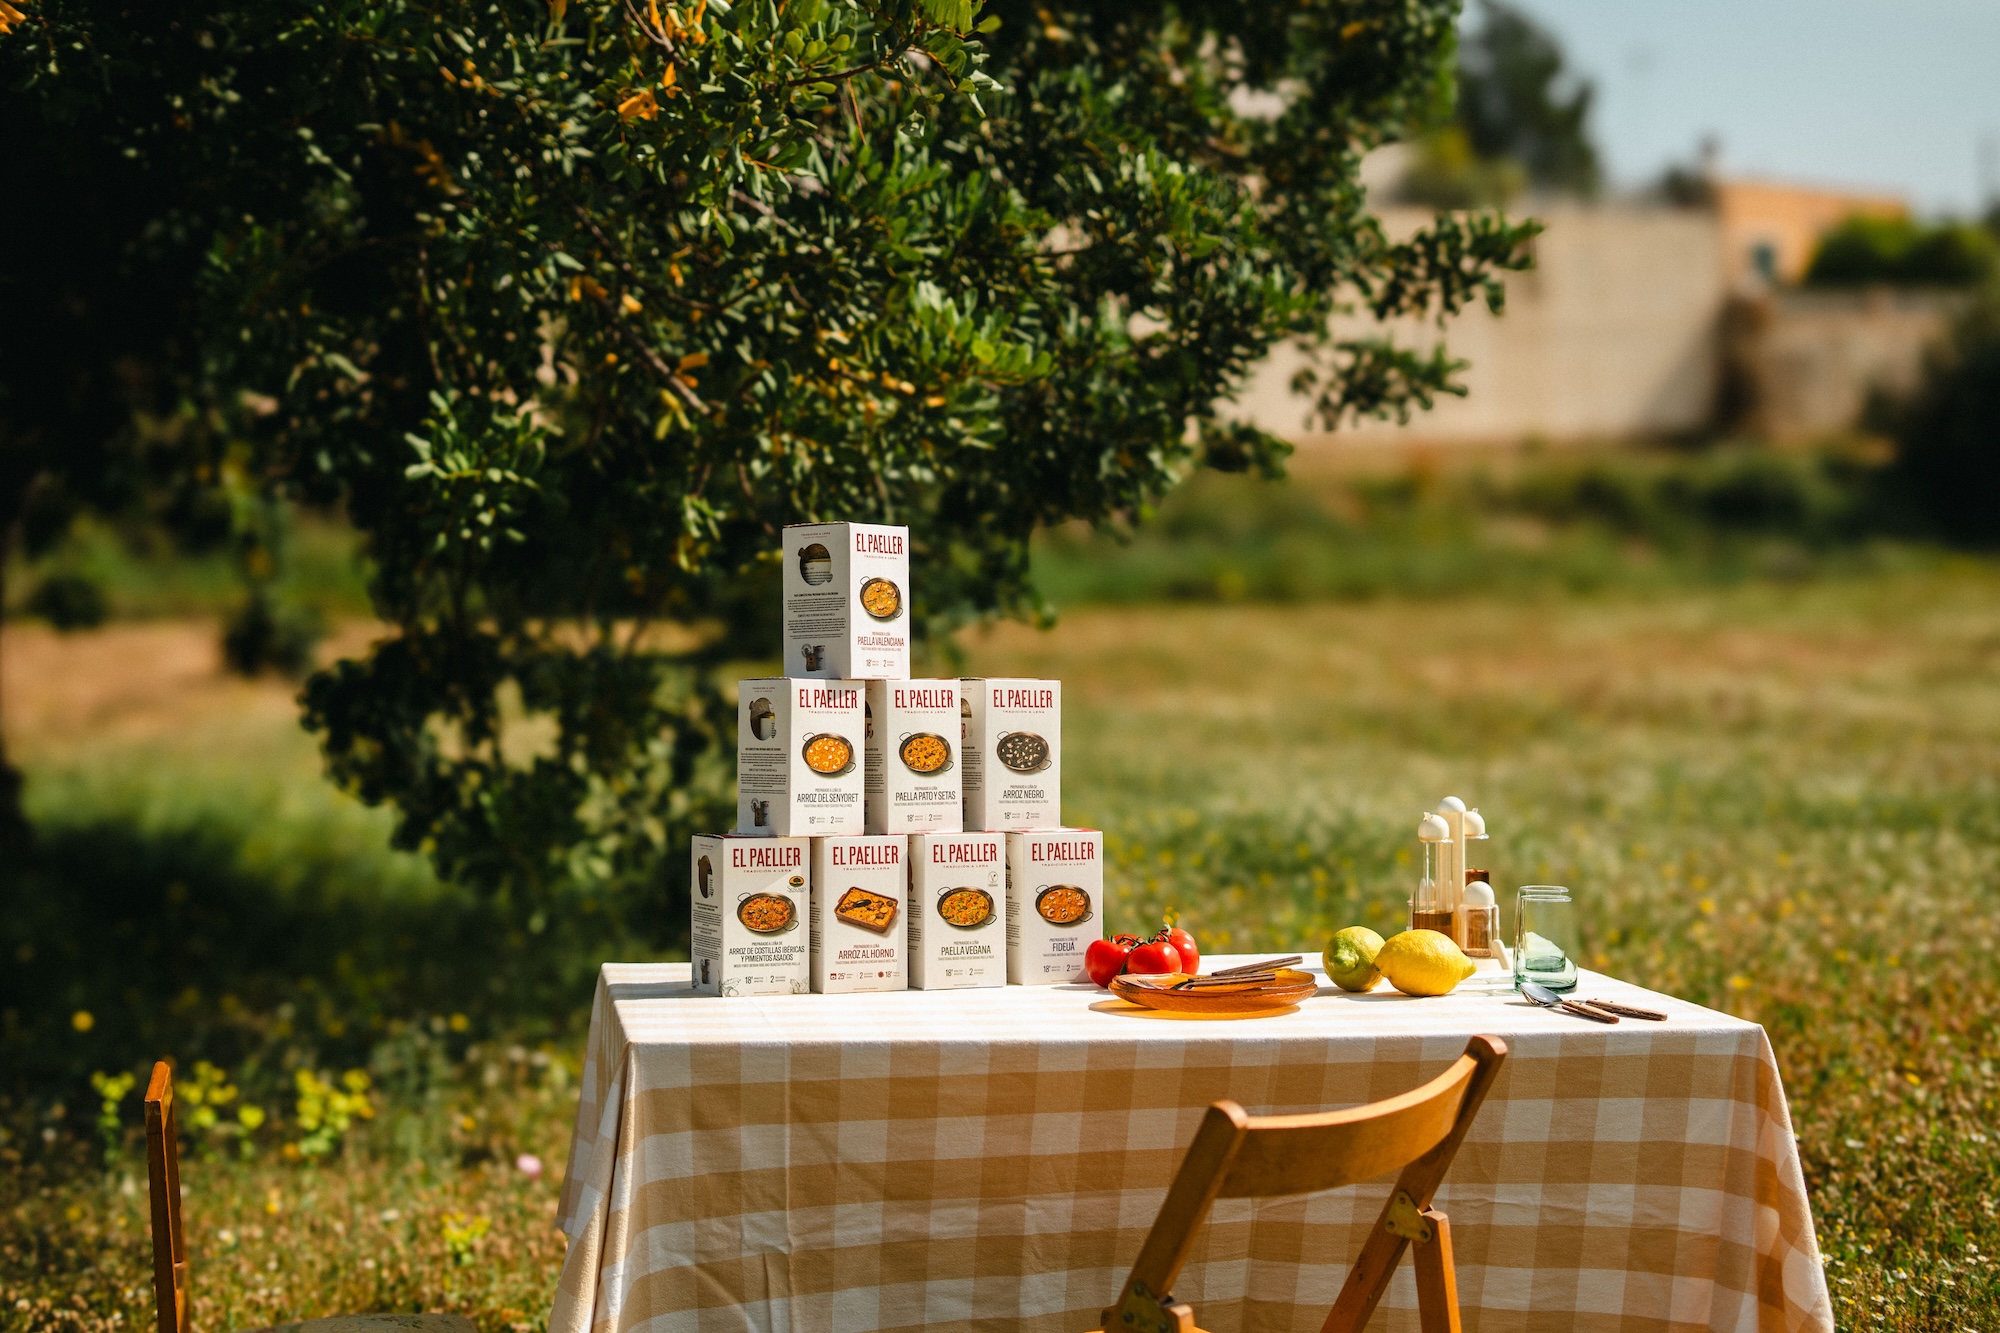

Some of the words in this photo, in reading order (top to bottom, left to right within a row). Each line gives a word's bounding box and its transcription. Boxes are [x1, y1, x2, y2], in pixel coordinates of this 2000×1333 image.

[856, 533, 866, 552] EL
[868, 534, 903, 554] PAELLER
[858, 636, 875, 645] PAELLA
[875, 637, 904, 646] VALENCIANA
[800, 689, 811, 707] EL
[814, 689, 857, 708] PAELLER
[895, 690, 907, 708] EL
[910, 690, 953, 708] PAELLER
[994, 690, 1005, 707] EL
[1008, 690, 1053, 708] PAELLER
[797, 793, 817, 802] ARROZ
[818, 793, 828, 802] DEL
[829, 793, 858, 802] SENYORET
[896, 792, 918, 801] PAELLA
[919, 792, 933, 800] PATO
[934, 791, 937, 800] Y
[938, 791, 956, 800] SETAS
[1003, 790, 1022, 798] ARROZ
[1024, 790, 1044, 798] NEGRO
[831, 816, 834, 824] 2
[733, 849, 746, 867] EL
[750, 848, 800, 867] PAELLER
[833, 847, 846, 865] EL
[850, 846, 898, 864] PAELLER
[934, 845, 946, 862] EL
[949, 844, 997, 862] PAELLER
[1032, 843, 1044, 861] EL
[1048, 842, 1094, 860] PAELLER
[941, 946, 965, 955] PAELLA
[965, 946, 991, 954] VEGANA
[1053, 941, 1075, 951] FIDEUÁ
[838, 950, 860, 959] ARROZ
[862, 950, 870, 958] AL
[871, 949, 894, 958] HORNO
